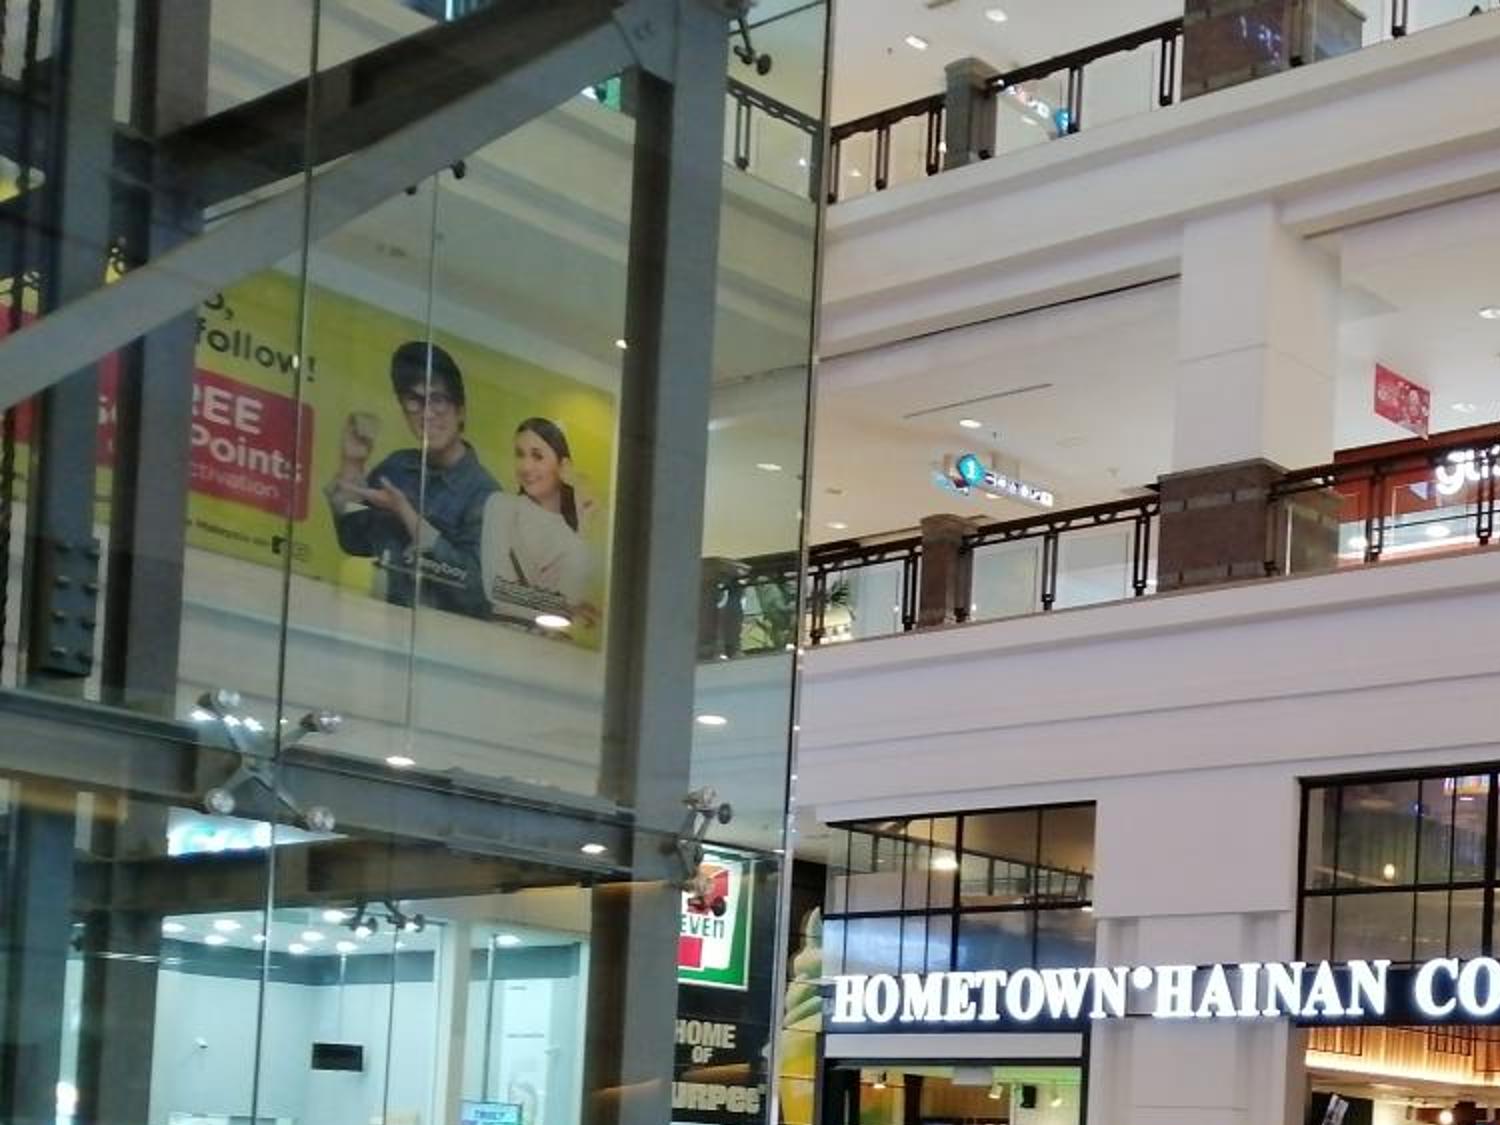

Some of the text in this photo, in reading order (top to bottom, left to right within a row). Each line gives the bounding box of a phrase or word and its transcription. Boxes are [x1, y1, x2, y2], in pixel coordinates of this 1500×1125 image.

[193, 384, 263, 435] EE
[675, 1019, 736, 1049] HOME
[692, 1046, 713, 1063] OF
